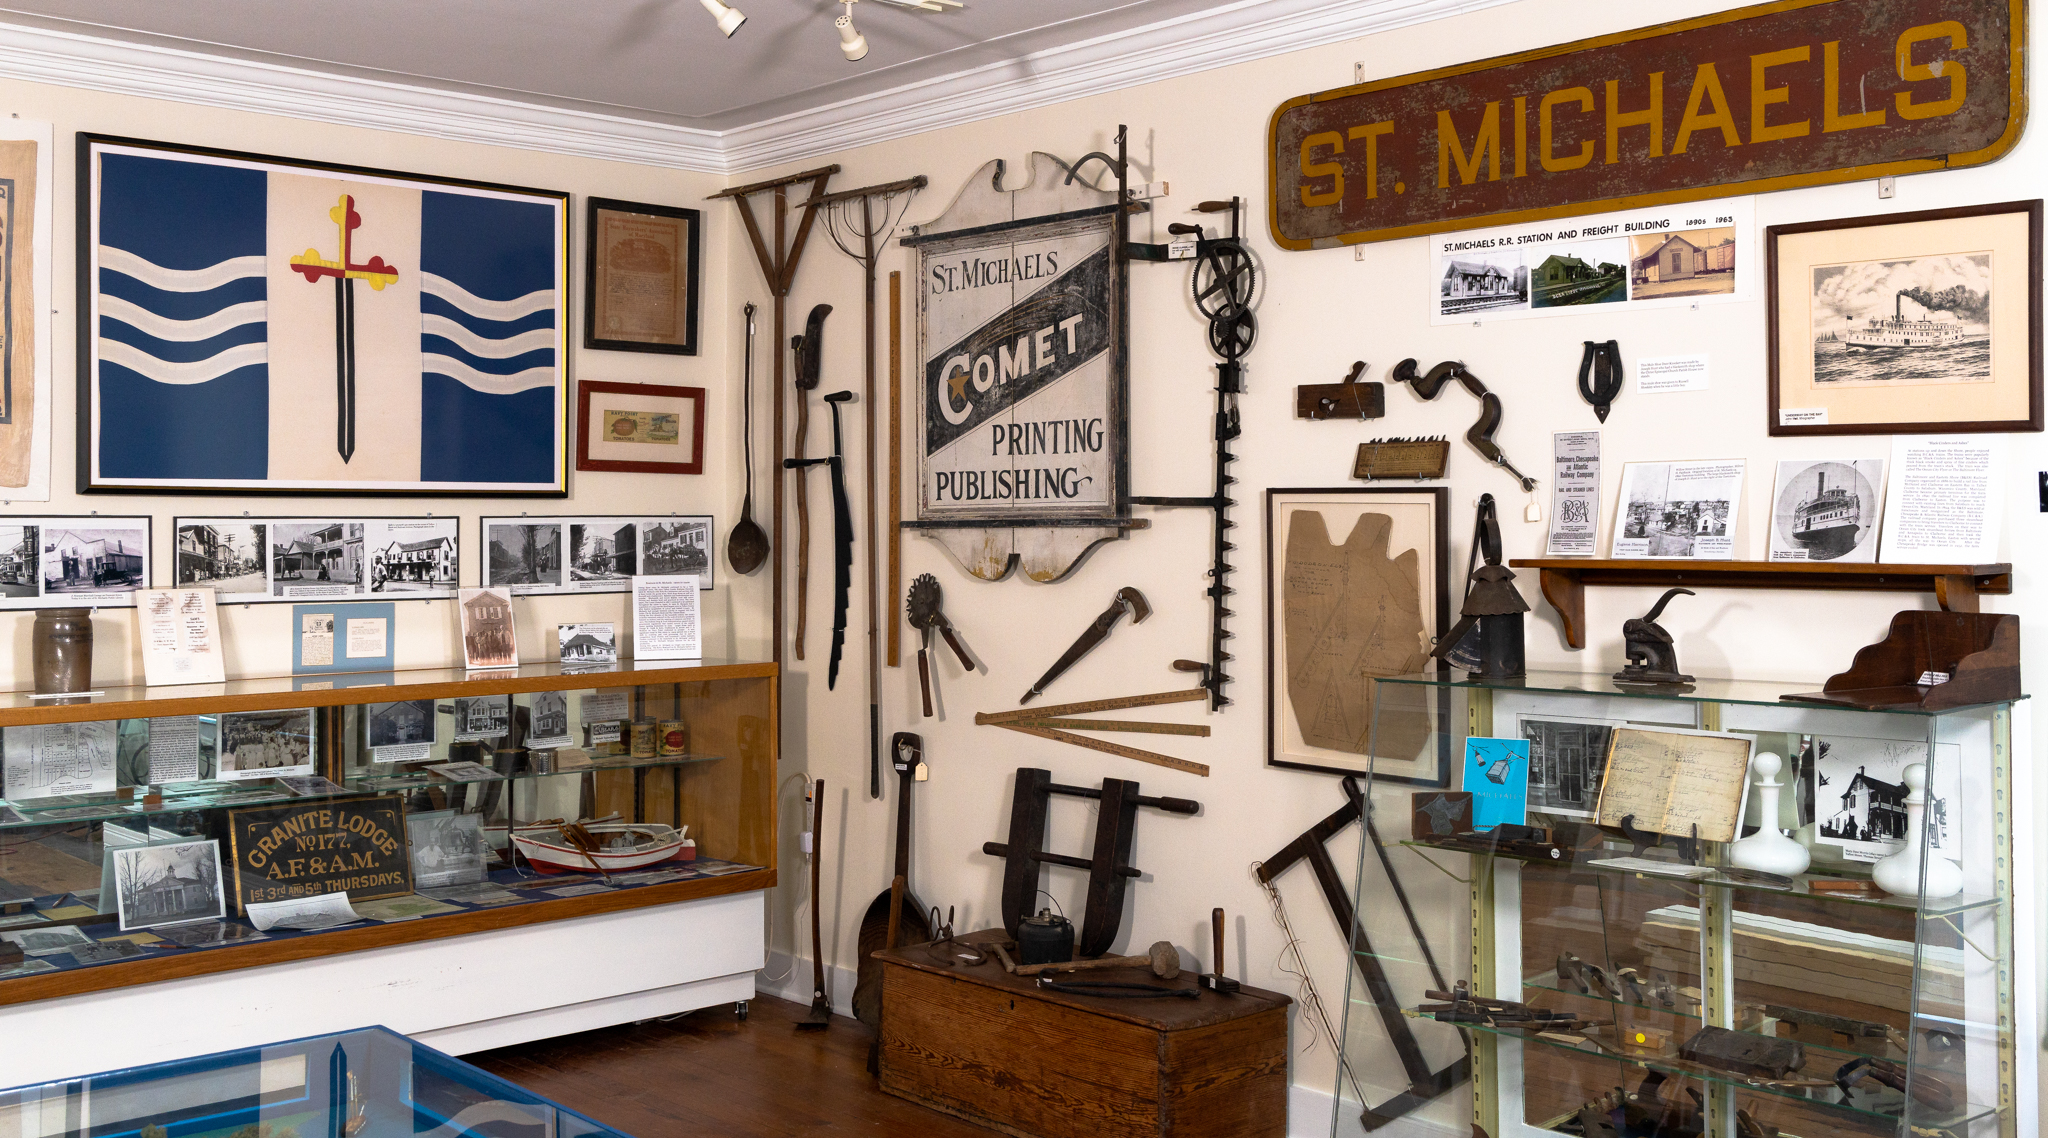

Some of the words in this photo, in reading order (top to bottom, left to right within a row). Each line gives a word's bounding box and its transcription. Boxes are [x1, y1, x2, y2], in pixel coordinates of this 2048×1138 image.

[1299, 119, 1406, 208] ST.
[1436, 20, 1969, 190] MICHAELS
[1456, 238, 1496, 252] MICHAELS
[1498, 237, 1514, 247] R.R.
[1517, 232, 1553, 246] STATION
[1557, 230, 1578, 240] AND
[1582, 224, 1619, 238] FREIGHT
[1624, 218, 1671, 232] BUILDING
[932, 264, 960, 295] ST.
[961, 251, 1058, 290] MICHAELS
[937, 312, 1084, 426] COMET
[992, 418, 1104, 456] PRINTING
[935, 467, 1093, 501] PUBLISHING
[248, 809, 333, 868] GRANITE
[337, 811, 398, 856] LODGE
[310, 856, 327, 875] &
[250, 888, 264, 902] 1st
[267, 885, 286, 900] 3rd
[289, 884, 304, 896] AND
[305, 882, 322, 895] 5th
[325, 871, 404, 892] THURSDAYS.
